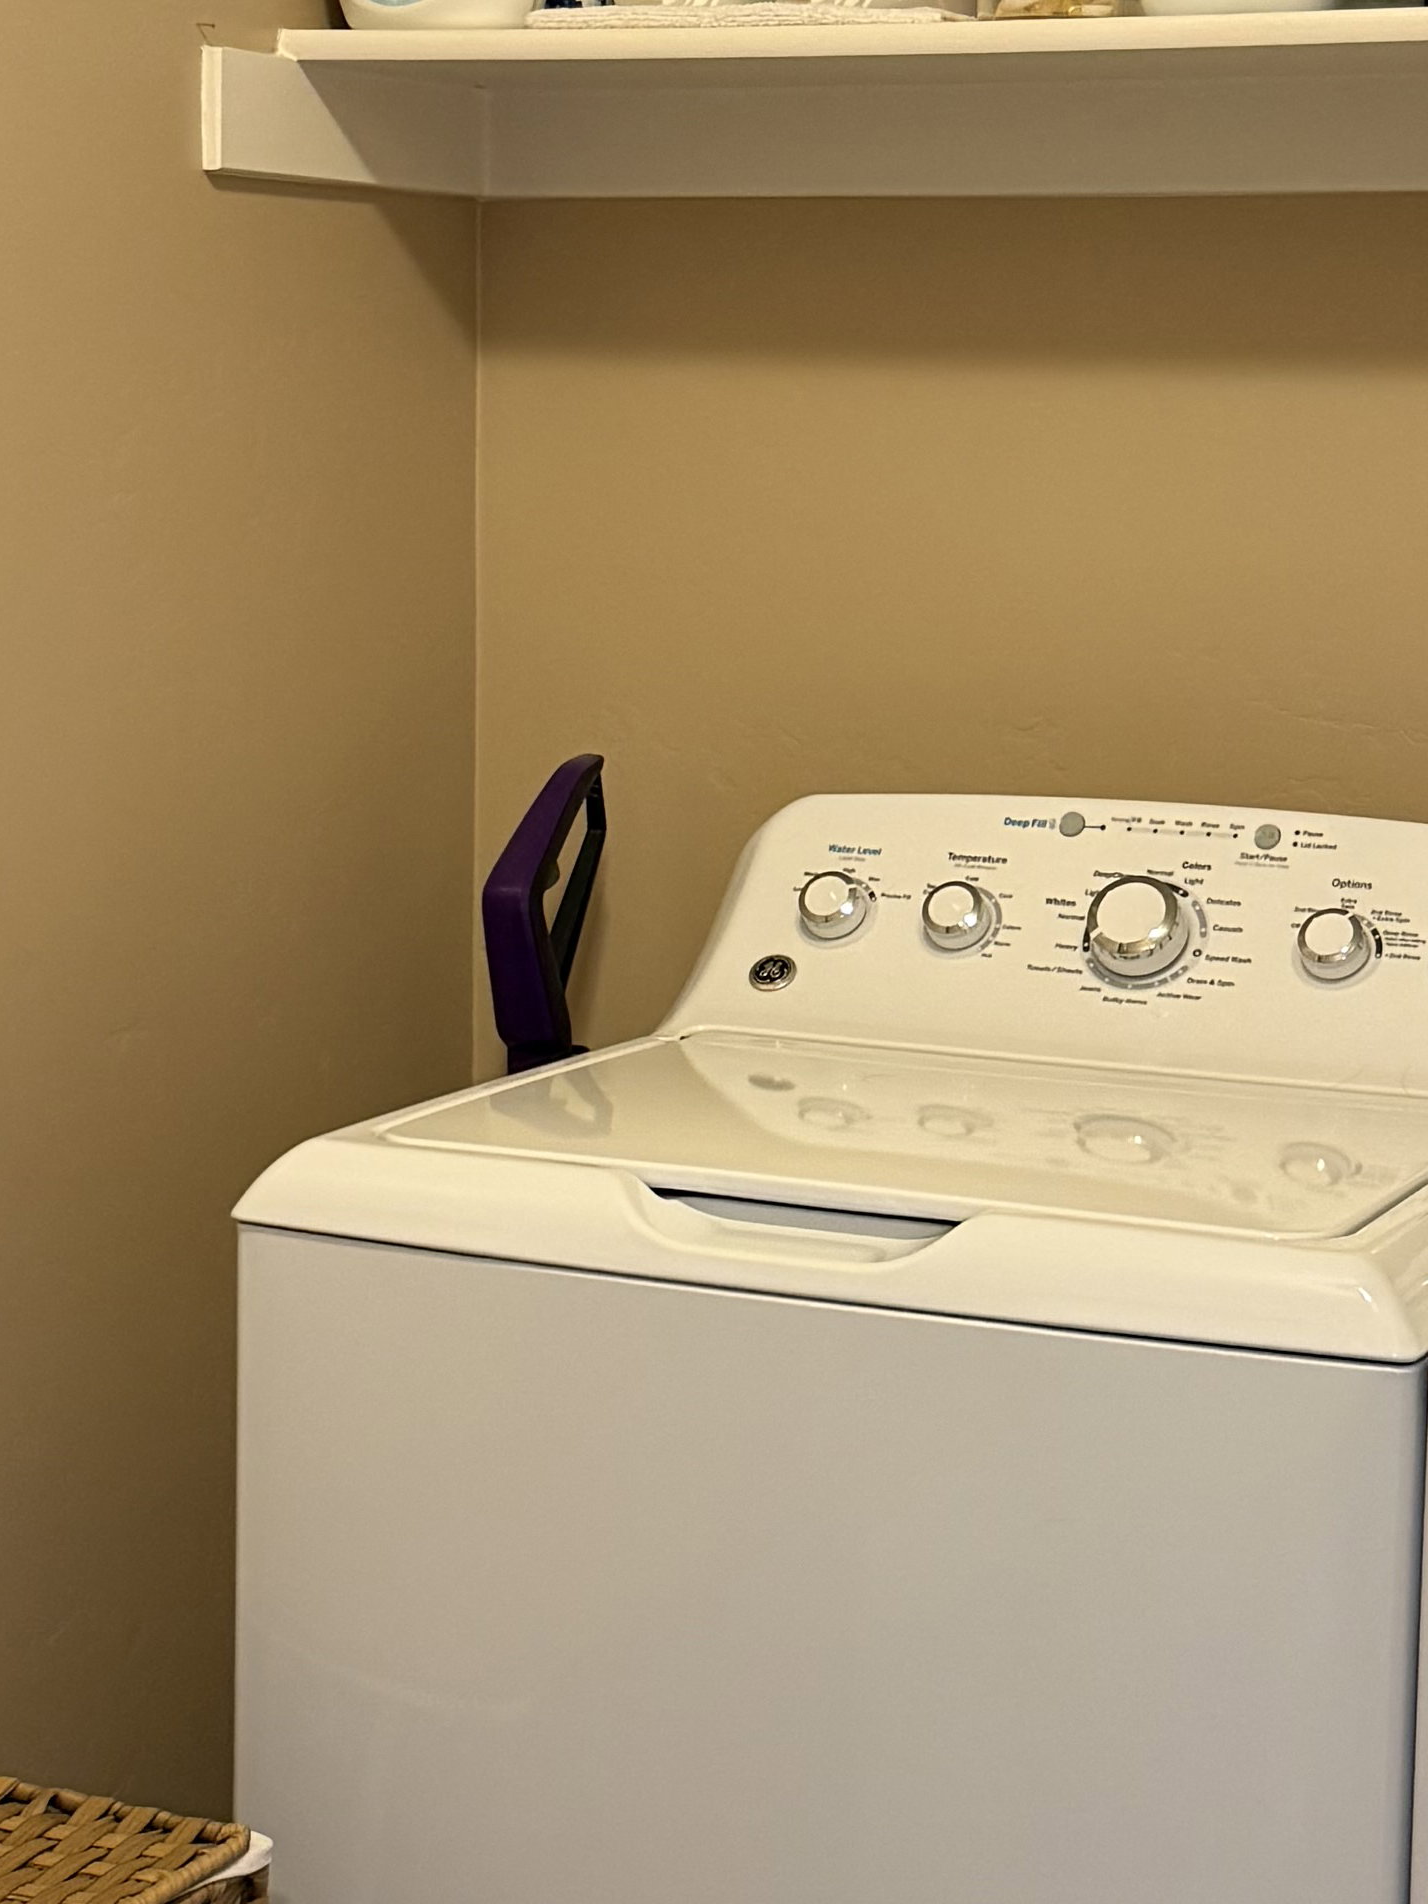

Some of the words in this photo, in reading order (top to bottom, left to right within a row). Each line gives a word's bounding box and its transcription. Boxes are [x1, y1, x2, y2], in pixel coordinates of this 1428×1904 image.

[1004, 816, 1030, 829] Deep
[1031, 818, 1048, 828] Fill
[1302, 830, 1324, 838] Pause
[828, 844, 856, 854] Water
[858, 846, 882, 856] Level
[948, 852, 1008, 864] Temperature
[1240, 852, 1288, 862] Start/Pause
[1182, 861, 1212, 871] Colors
[1184, 878, 1204, 886] Light
[1332, 878, 1372, 890] Options
[1046, 898, 1076, 907] Whites
[1204, 954, 1230, 962] Speed
